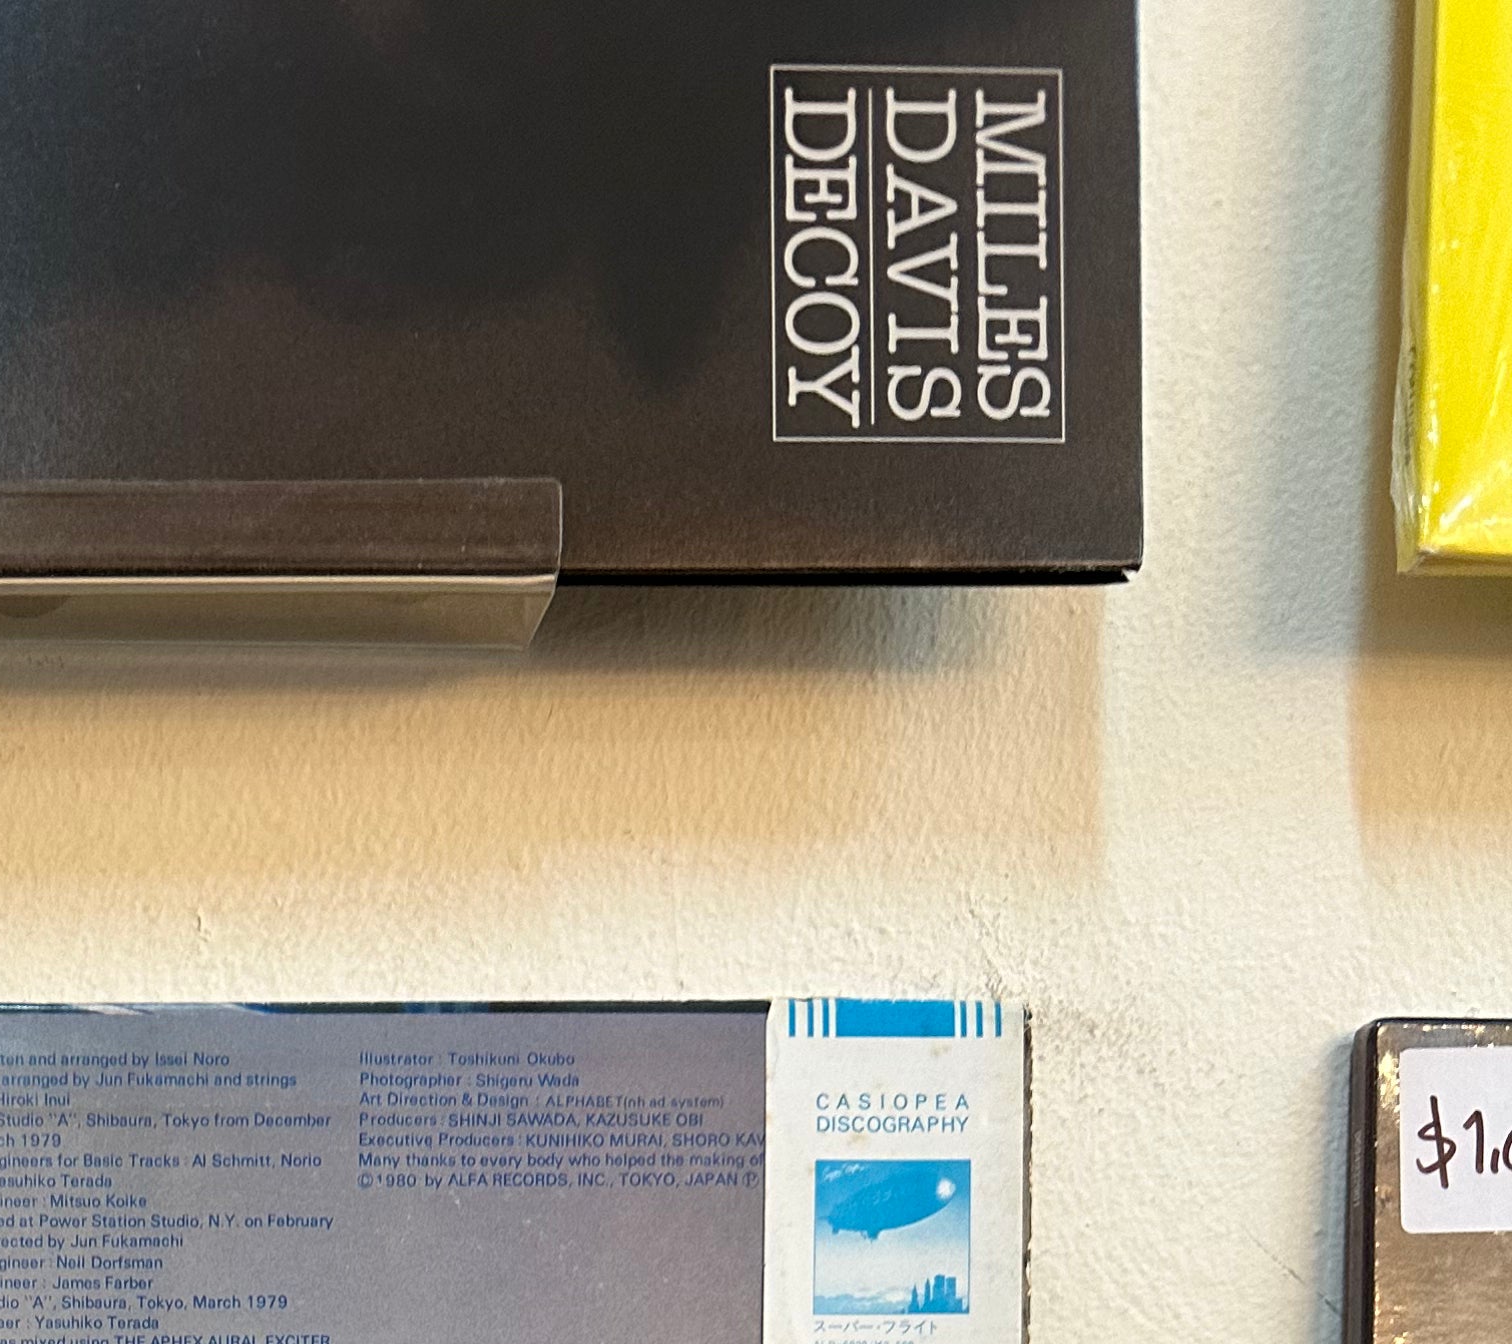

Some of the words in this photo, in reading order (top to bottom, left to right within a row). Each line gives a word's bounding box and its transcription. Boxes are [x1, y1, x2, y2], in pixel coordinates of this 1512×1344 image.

[784, 88, 860, 428] DECOY
[886, 88, 961, 421] DAVIS
[975, 89, 1051, 420] MILES
[360, 1073, 462, 1088] Photographer
[538, 1074, 579, 1087] Wada
[816, 1093, 969, 1110] CASIOPEA
[816, 1115, 969, 1134] DISCOGRAPHY
[448, 1173, 487, 1187] ALFA
[685, 1173, 737, 1186] JAPAN
[814, 1320, 938, 1334] スーパー・フライト
